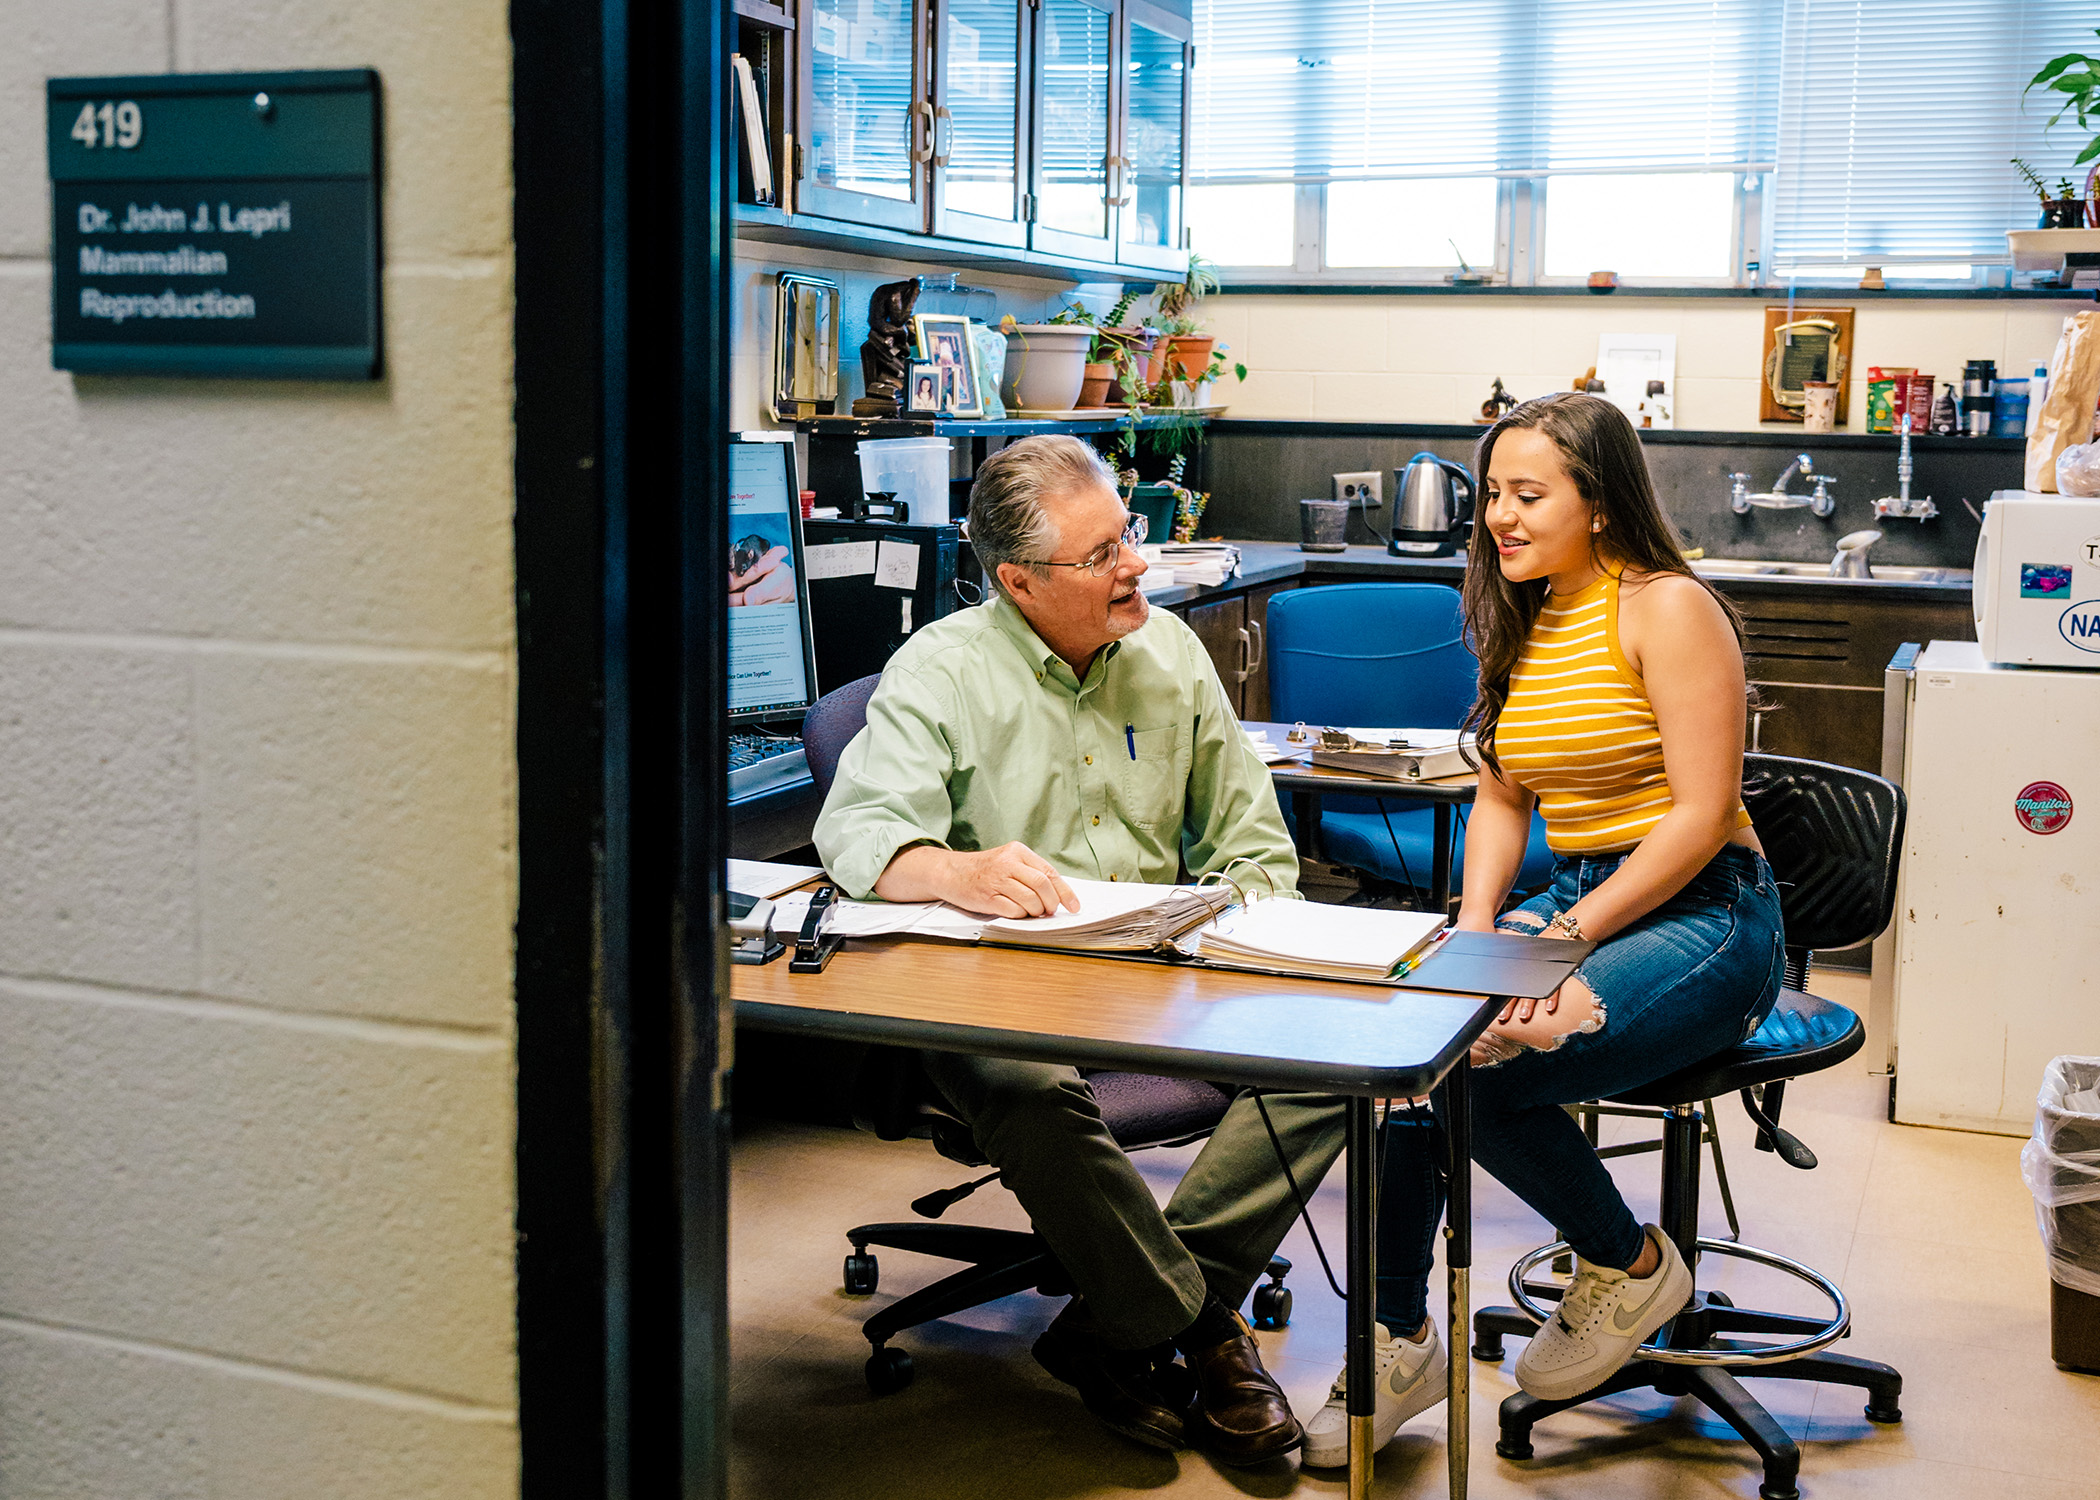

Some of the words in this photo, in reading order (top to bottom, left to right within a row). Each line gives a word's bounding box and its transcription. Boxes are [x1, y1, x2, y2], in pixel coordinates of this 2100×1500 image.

[71, 101, 143, 148] 419
[78, 203, 116, 233] Dr.
[120, 203, 186, 232] John
[190, 202, 214, 232] J.
[218, 201, 291, 238] Lepri
[79, 245, 228, 274] Mammalian
[79, 288, 256, 323] Reproduction
[2085, 544, 2100, 559] T
[753, 670, 772, 678] Together?
[2015, 798, 2071, 812] Manitou
